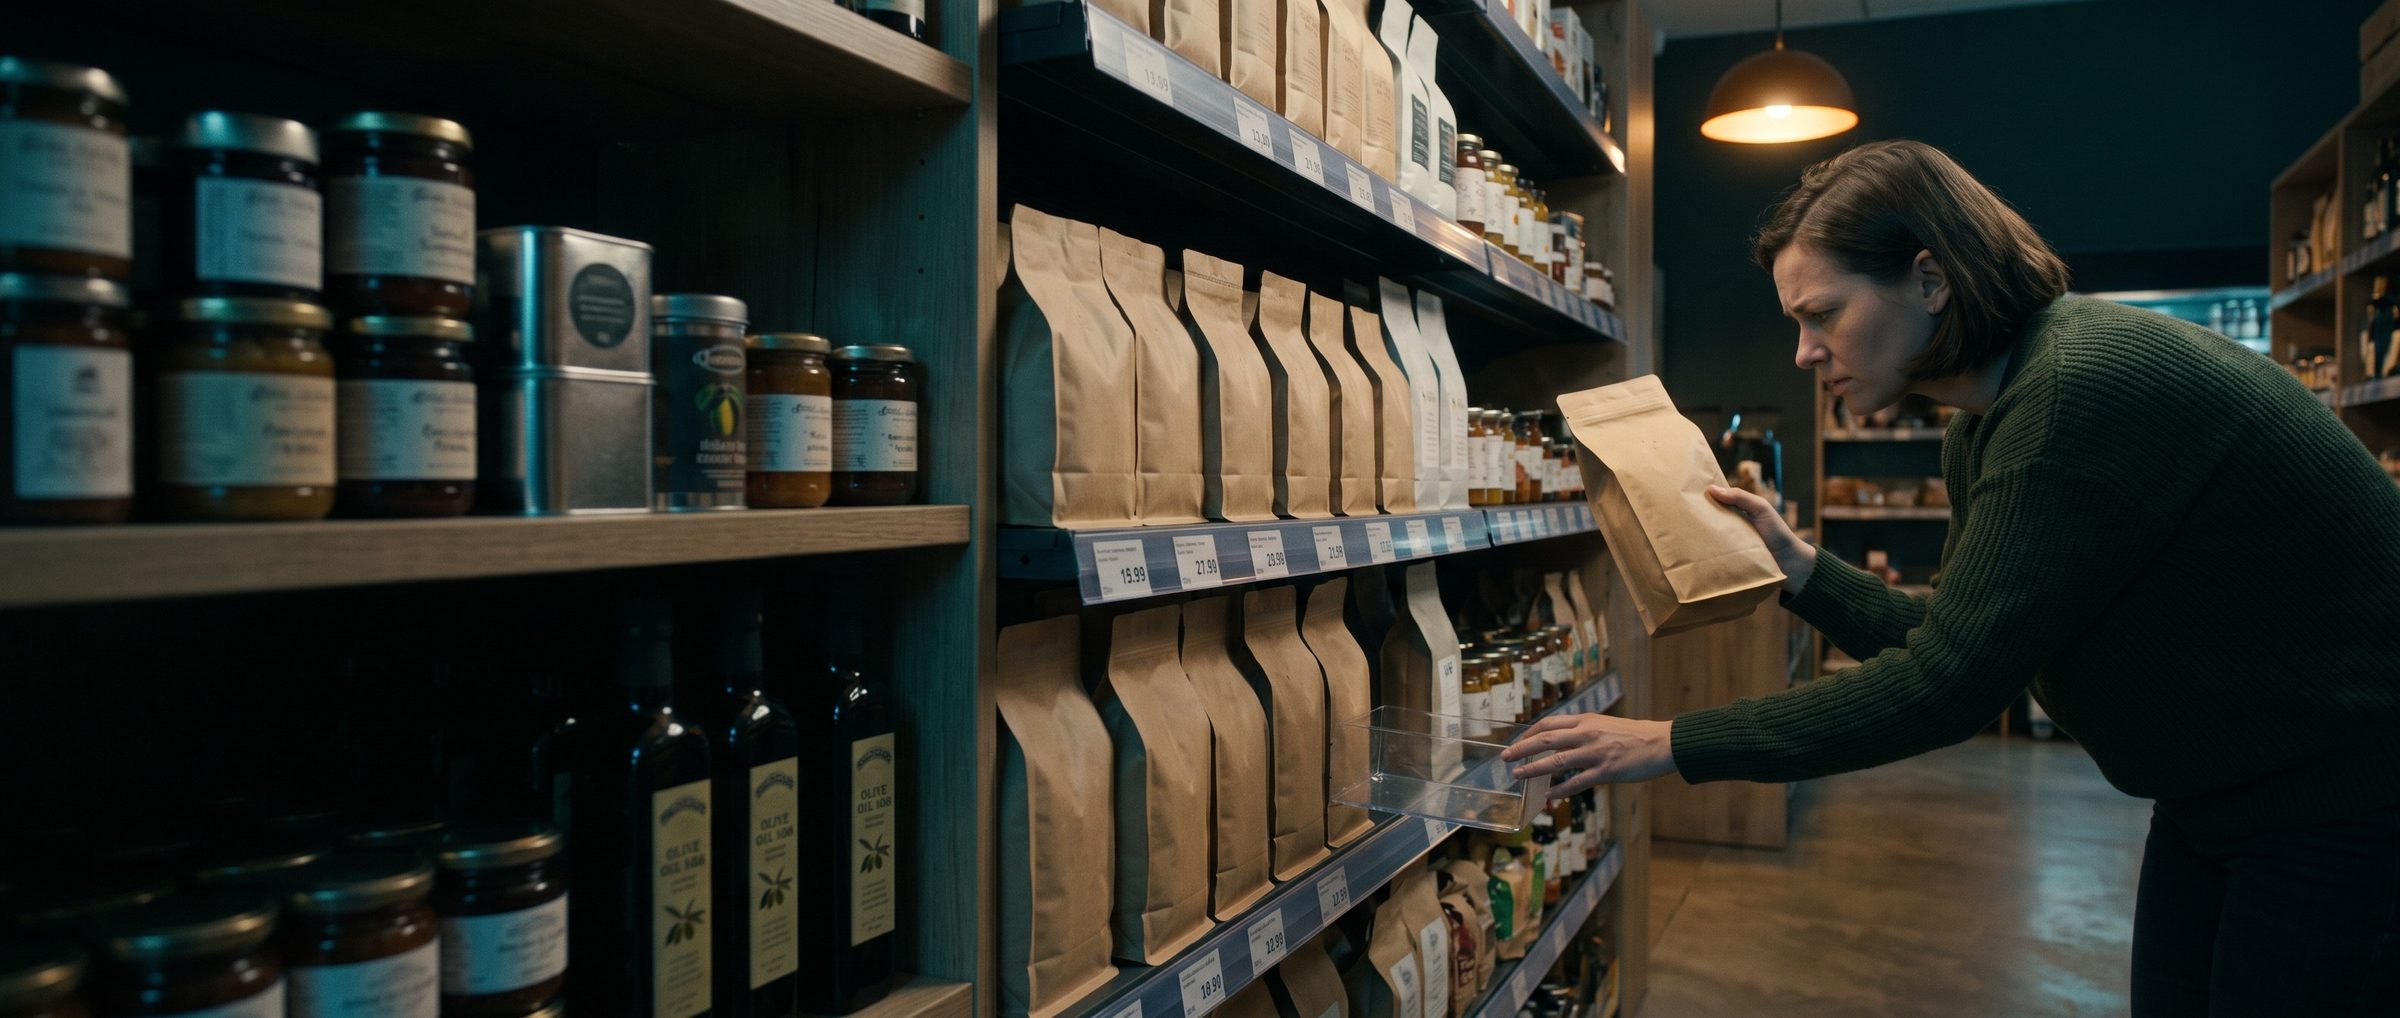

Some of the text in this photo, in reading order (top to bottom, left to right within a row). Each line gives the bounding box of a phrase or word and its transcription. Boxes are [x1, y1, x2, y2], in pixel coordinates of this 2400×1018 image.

[1195, 559, 1218, 575] 27.99
[860, 784, 888, 801] OLIVE
[857, 799, 873, 814] OIL
